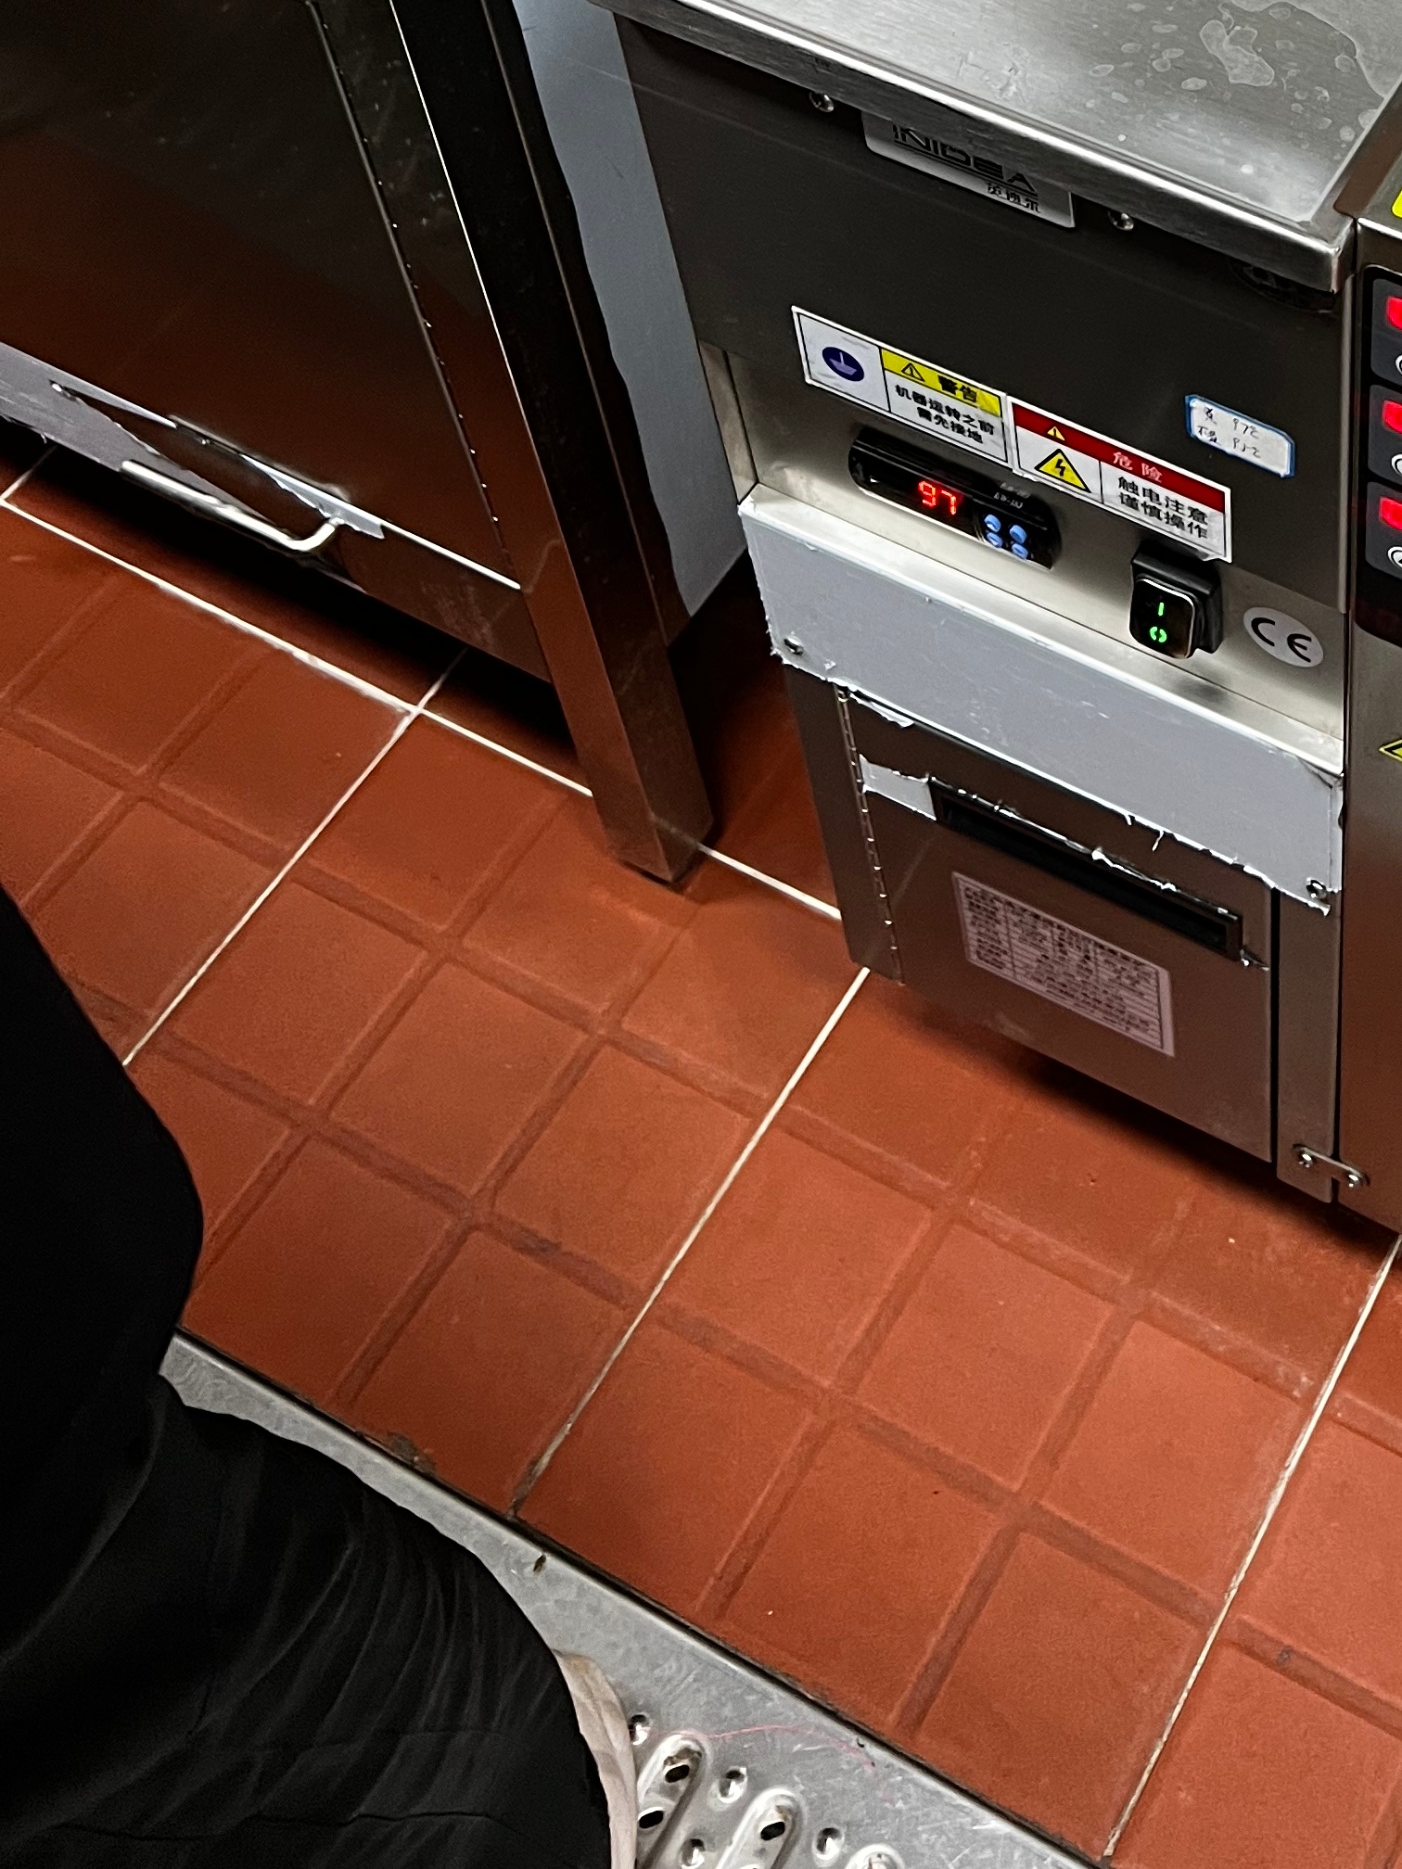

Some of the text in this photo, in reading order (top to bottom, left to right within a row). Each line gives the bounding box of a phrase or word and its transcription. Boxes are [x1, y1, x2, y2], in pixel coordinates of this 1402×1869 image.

[894, 383, 996, 436] 机器运转之前
[937, 375, 978, 404] 警告
[1112, 450, 1164, 484] 危险
[917, 479, 958, 516] 97
[1117, 475, 1209, 527] 触电注意
[1118, 491, 1209, 541] 谨慎操作
[1250, 616, 1312, 664] CE
